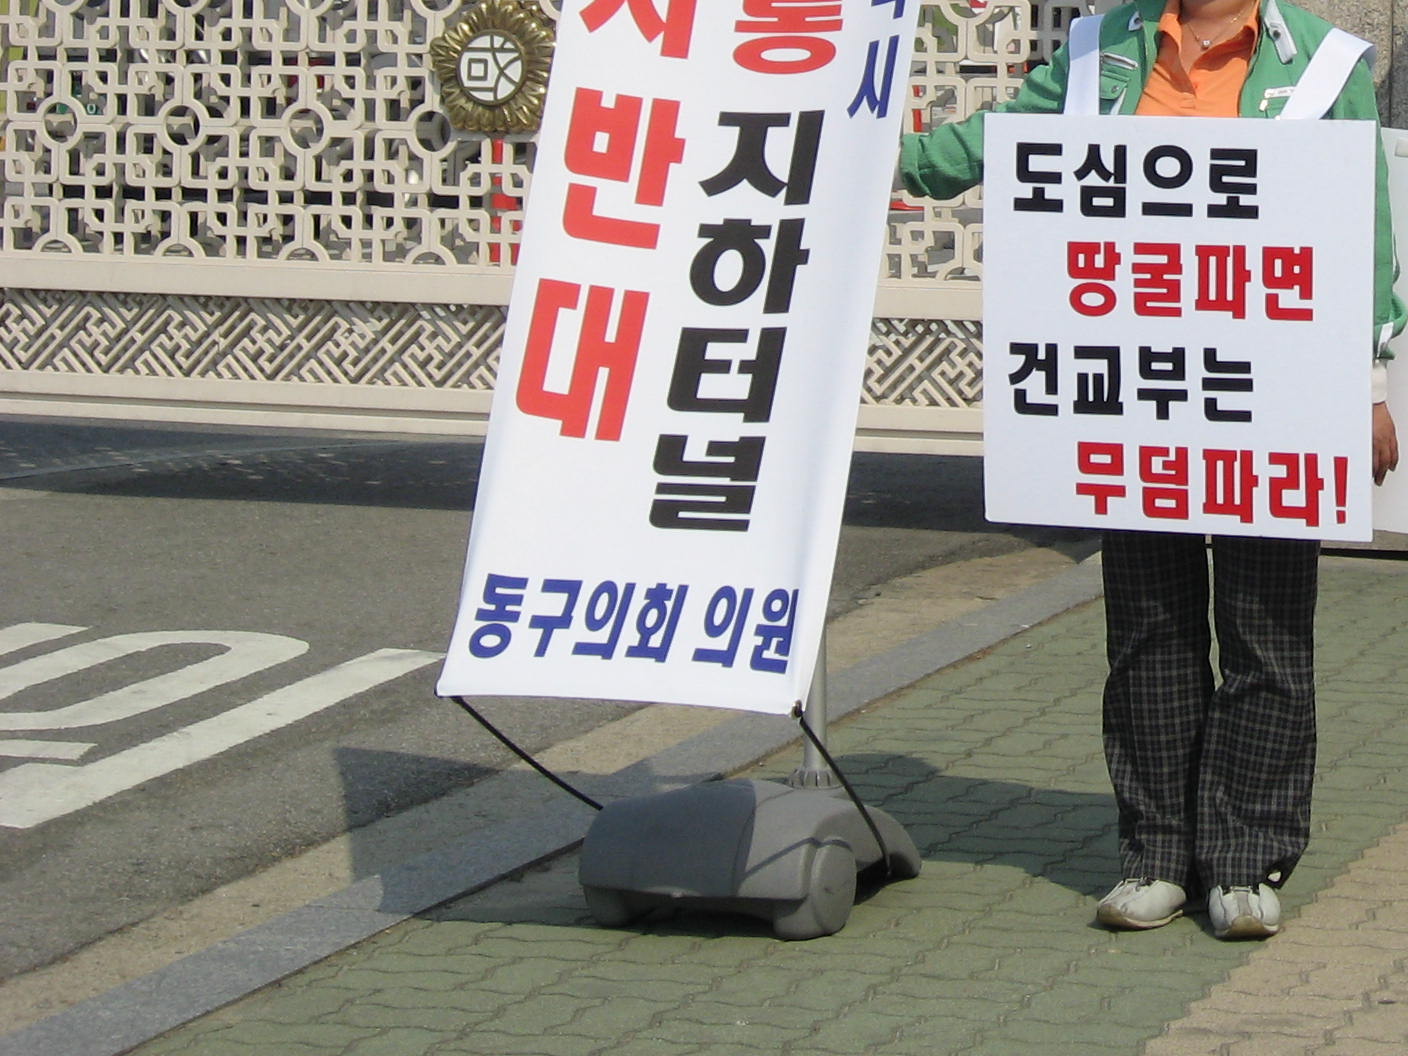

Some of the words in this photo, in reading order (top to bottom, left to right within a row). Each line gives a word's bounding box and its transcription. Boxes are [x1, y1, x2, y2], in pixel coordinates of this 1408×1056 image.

[1013, 141, 1260, 220] 도심으로
[648, 109, 825, 532] 지하터널
[1067, 240, 1314, 321] 땅굴파면
[1007, 341, 1254, 423] 건교부는
[1075, 440, 1349, 527] 무덤파라!
[469, 573, 689, 663] 동구의회
[692, 584, 800, 675] 의원
